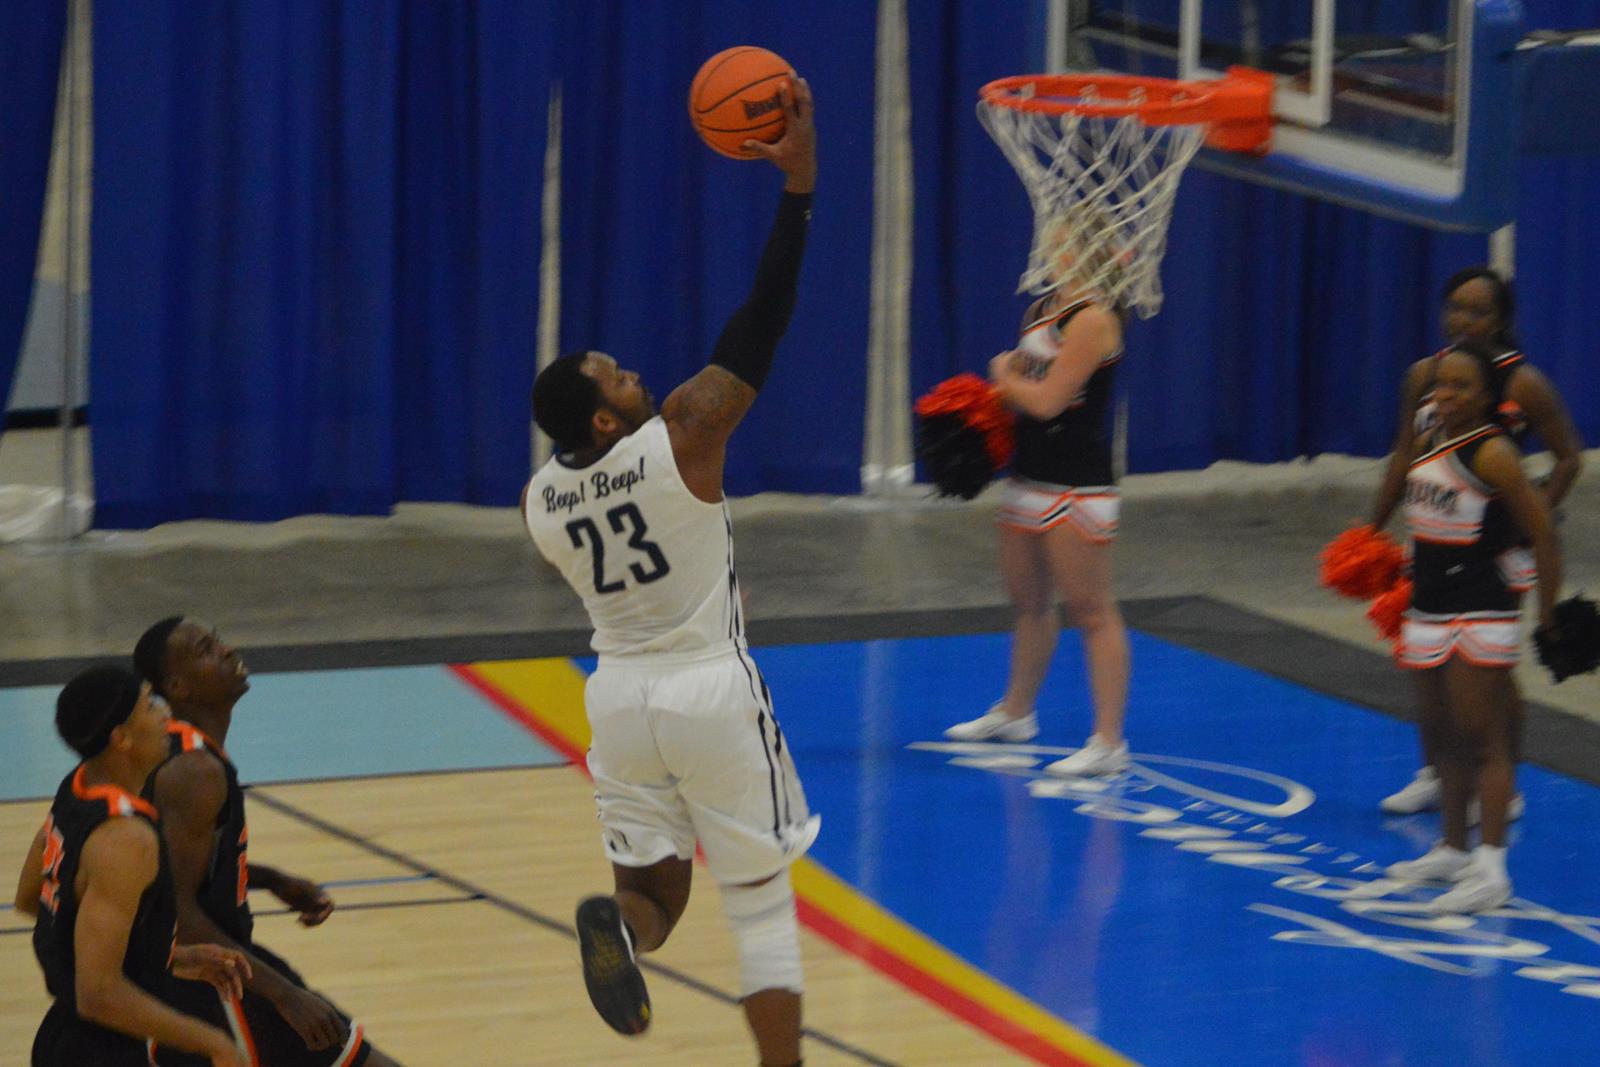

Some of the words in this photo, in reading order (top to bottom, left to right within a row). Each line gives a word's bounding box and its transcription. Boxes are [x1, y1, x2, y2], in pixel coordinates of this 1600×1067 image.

[542, 481, 585, 514] Beep!
[591, 456, 645, 499] Beep!
[565, 502, 671, 594] 23
